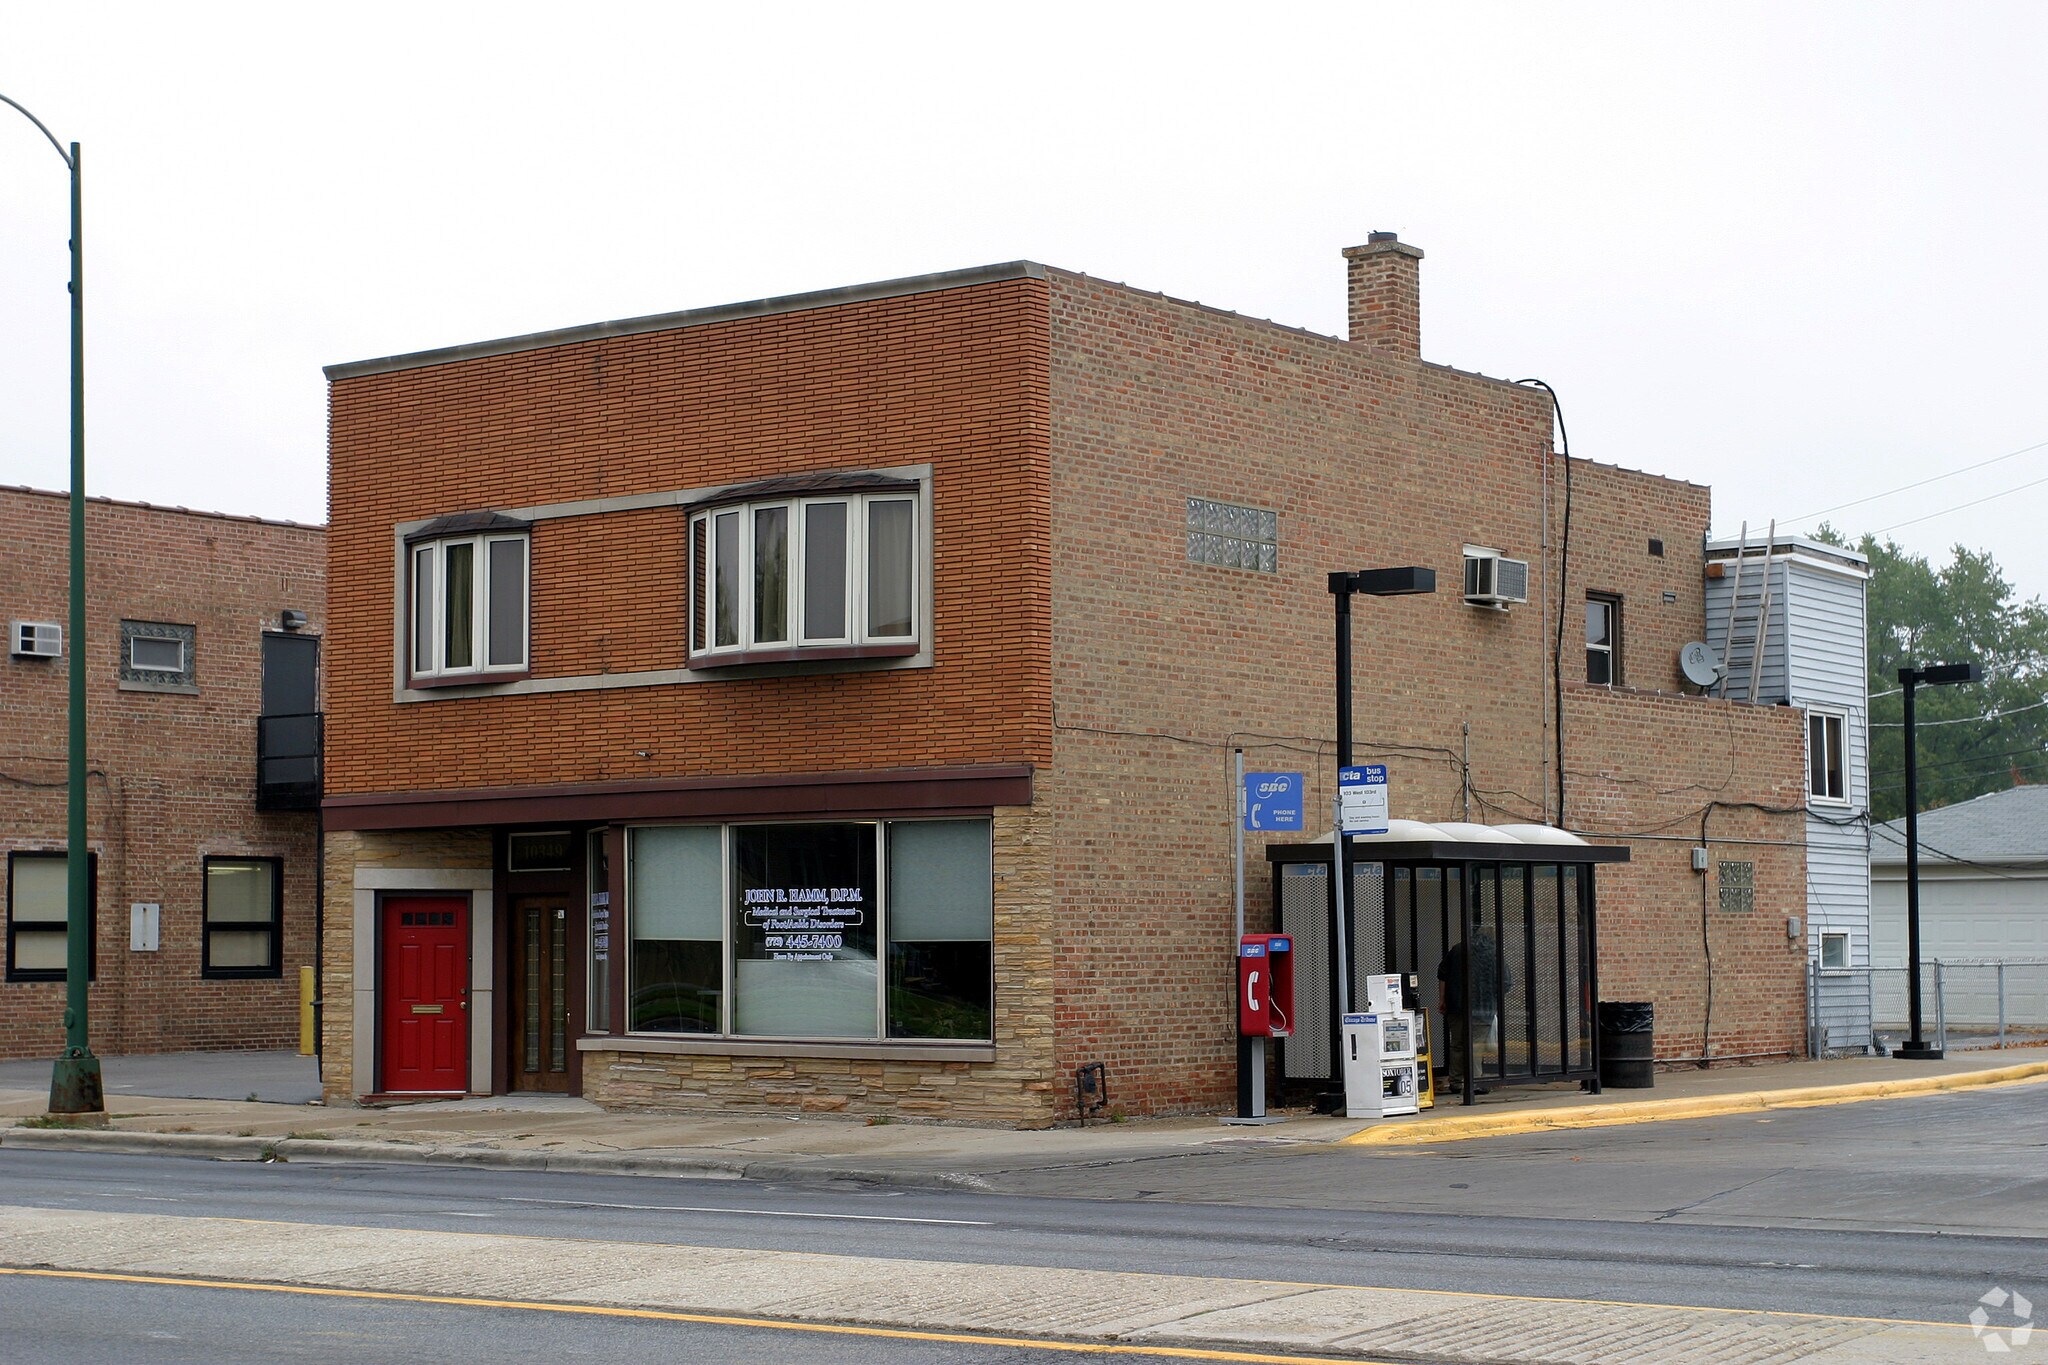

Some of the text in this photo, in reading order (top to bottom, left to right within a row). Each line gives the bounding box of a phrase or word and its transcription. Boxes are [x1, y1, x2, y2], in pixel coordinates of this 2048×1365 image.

[1342, 771, 1361, 781] cta
[1366, 767, 1381, 775] bus
[1366, 775, 1384, 783] stop
[1259, 783, 1288, 792] SBC
[744, 888, 863, 905] JOHN R. HAMM, D.P.M.
[752, 906, 856, 918] Medical and Surgical Treatment
[762, 920, 771, 930] of
[810, 919, 844, 929] Disorders
[786, 934, 843, 948] 445-7400
[1400, 1080, 1412, 1094] 05
